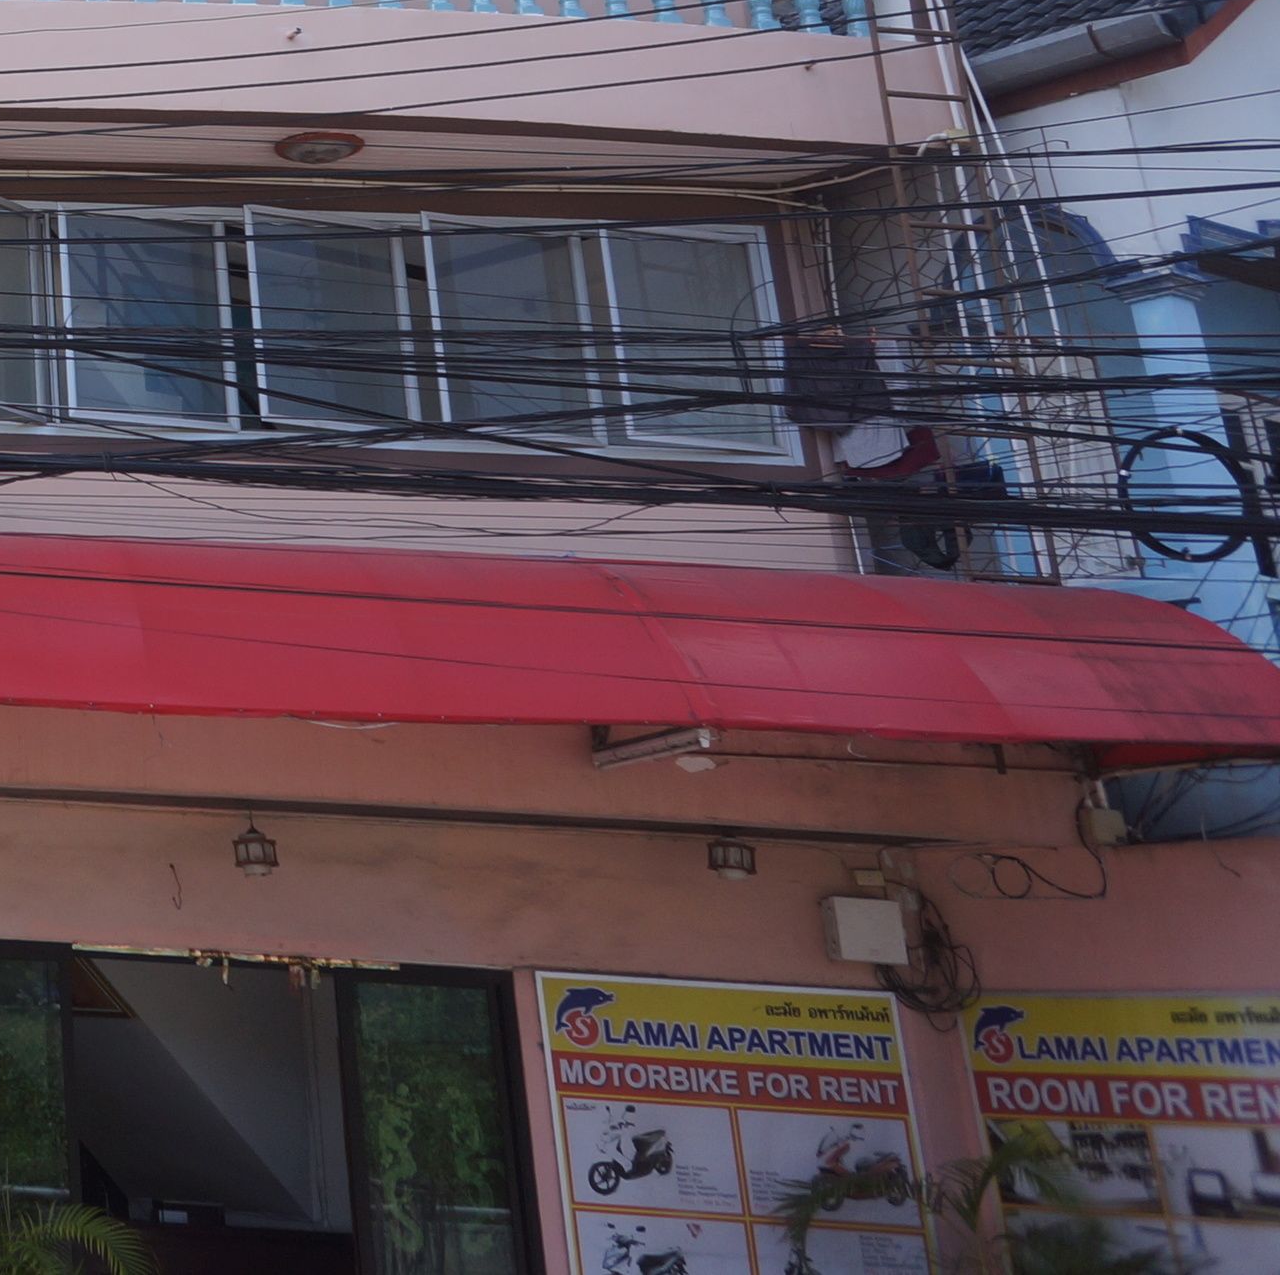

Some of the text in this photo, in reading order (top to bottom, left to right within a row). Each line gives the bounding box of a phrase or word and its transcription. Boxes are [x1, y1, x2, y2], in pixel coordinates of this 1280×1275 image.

[602, 1018, 893, 1061] LAMAI APARTMENT
[1017, 1035, 1108, 1062] LAMAI
[559, 1058, 900, 1106] MOTORBIKE FOR RENT
[986, 1077, 1101, 1115] ROOM
[1108, 1079, 1193, 1118] FOR
